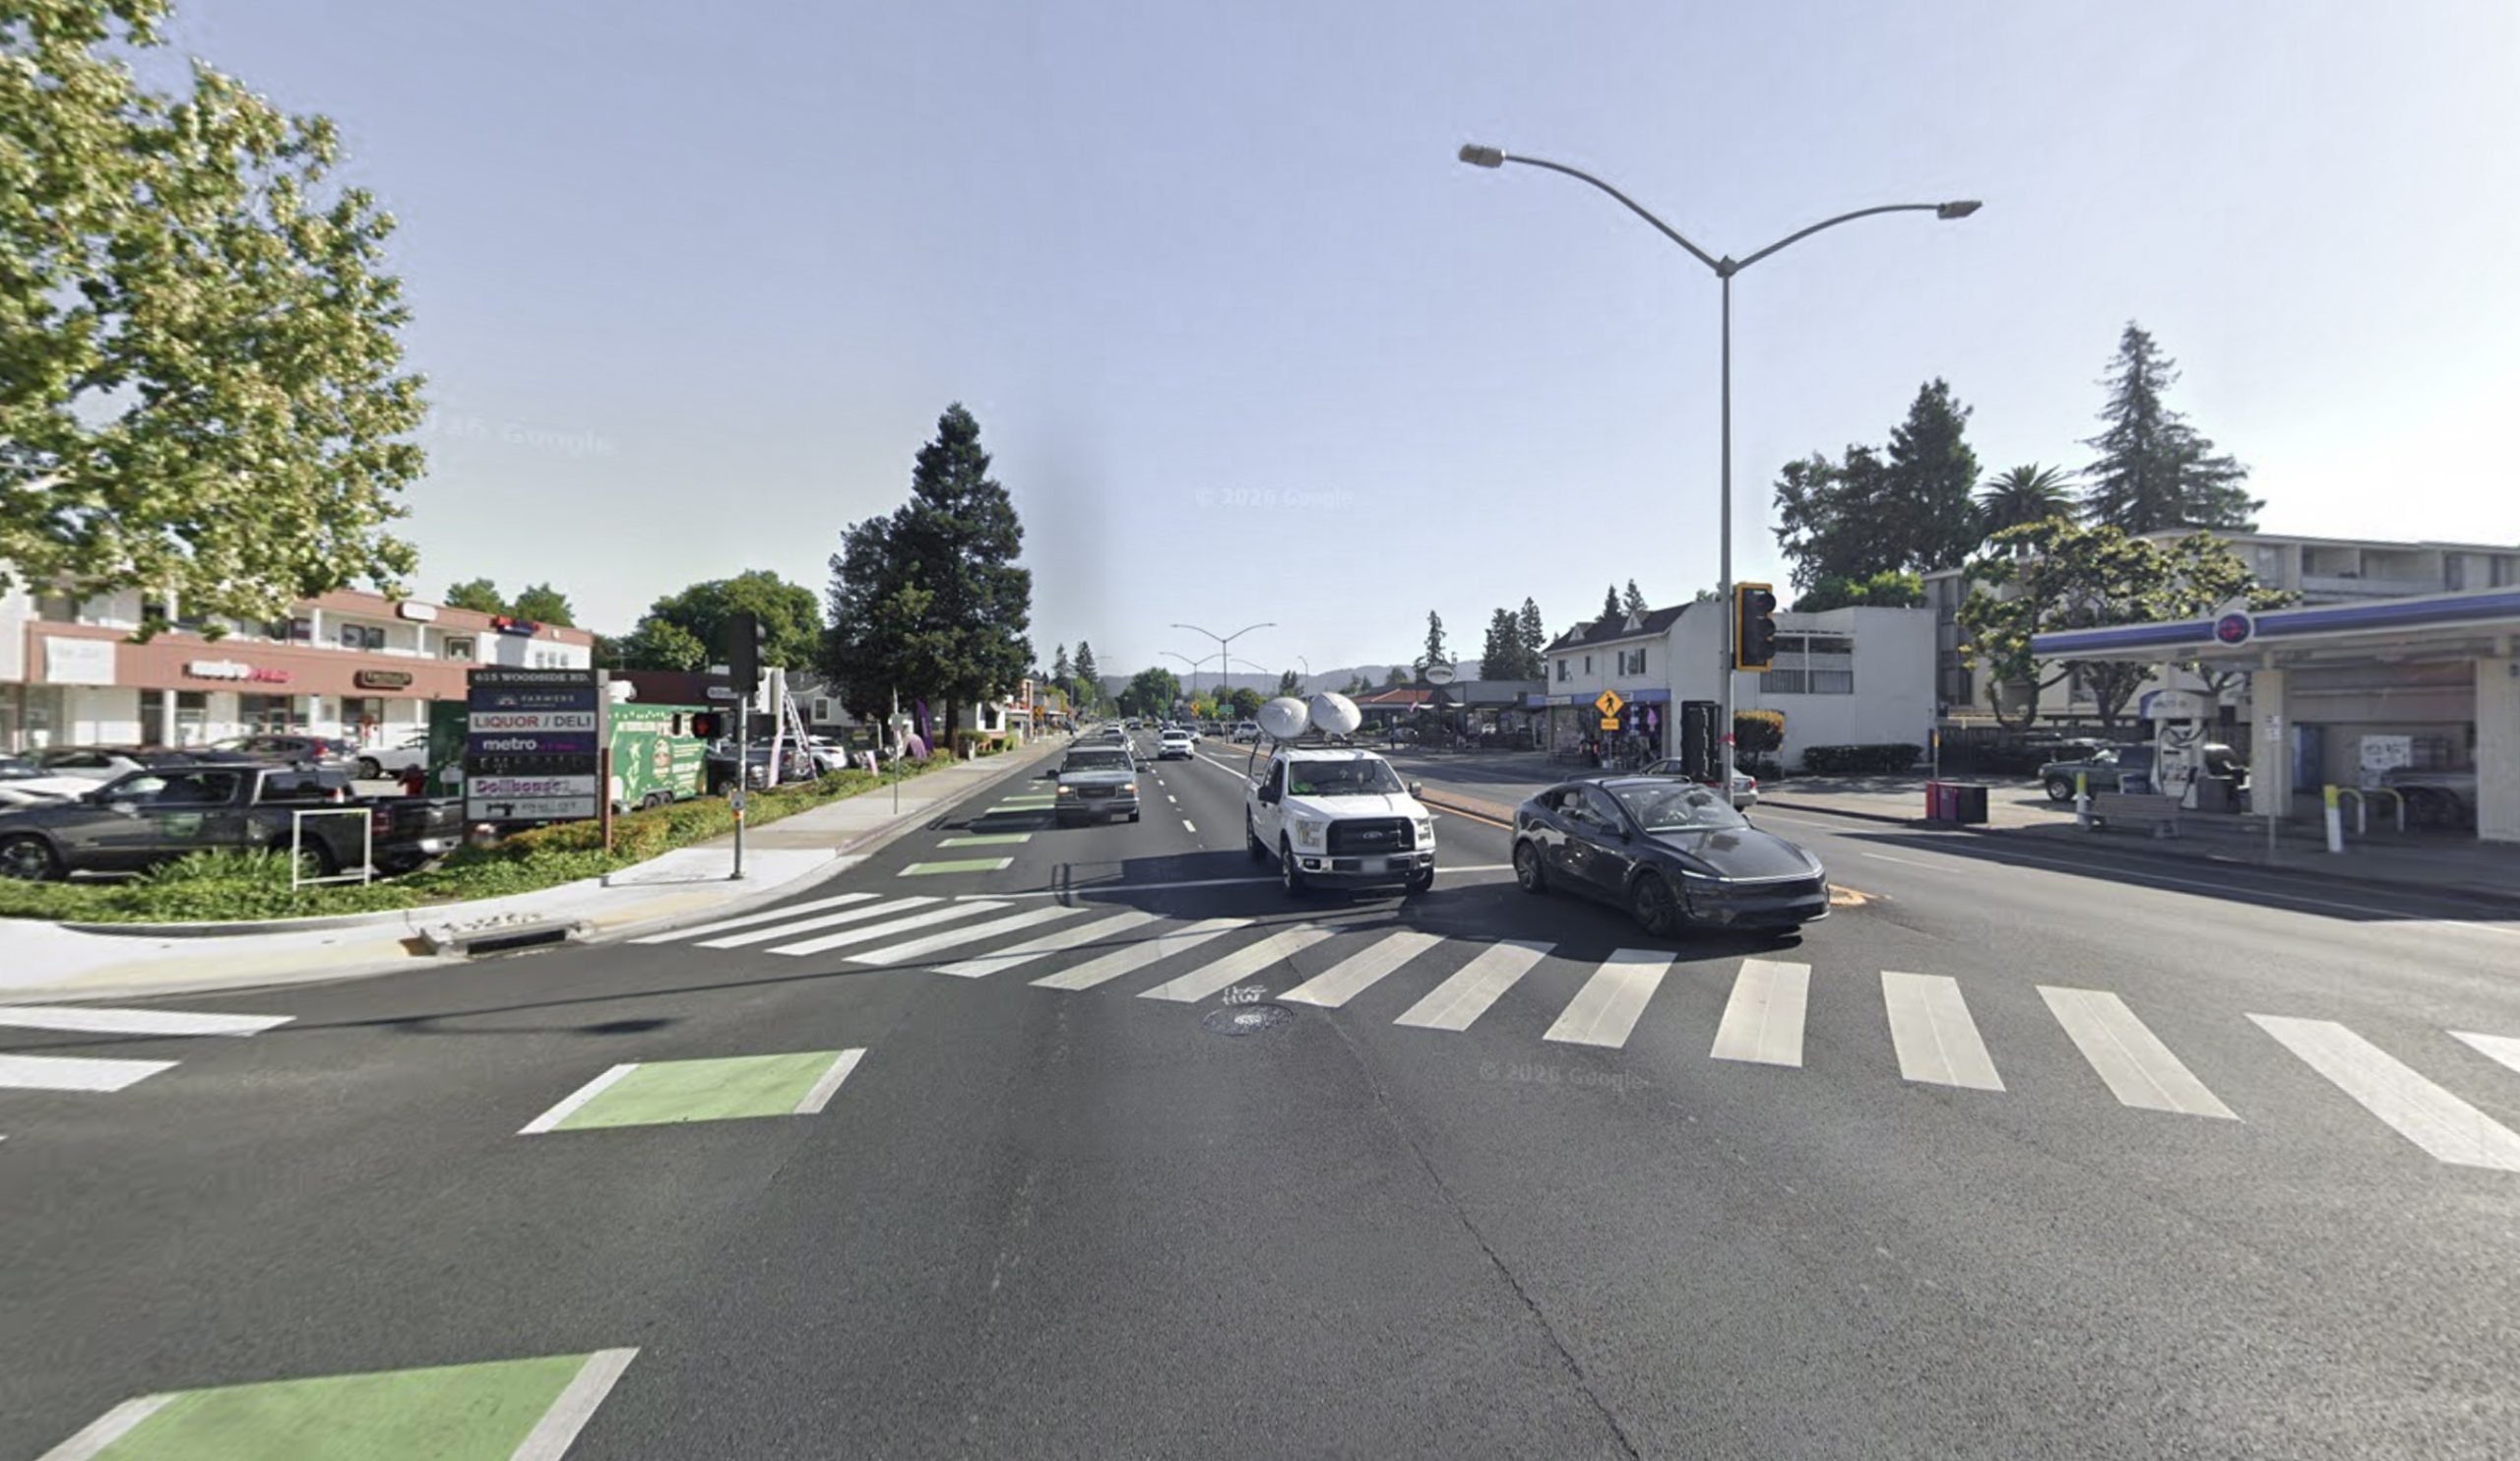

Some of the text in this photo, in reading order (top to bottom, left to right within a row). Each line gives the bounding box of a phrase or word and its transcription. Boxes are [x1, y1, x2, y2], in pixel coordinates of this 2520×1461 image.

[501, 672, 566, 682] WOODSIDE
[474, 716, 539, 728] LIQUOR
[553, 715, 592, 728] DELI
[482, 736, 537, 751] metro
